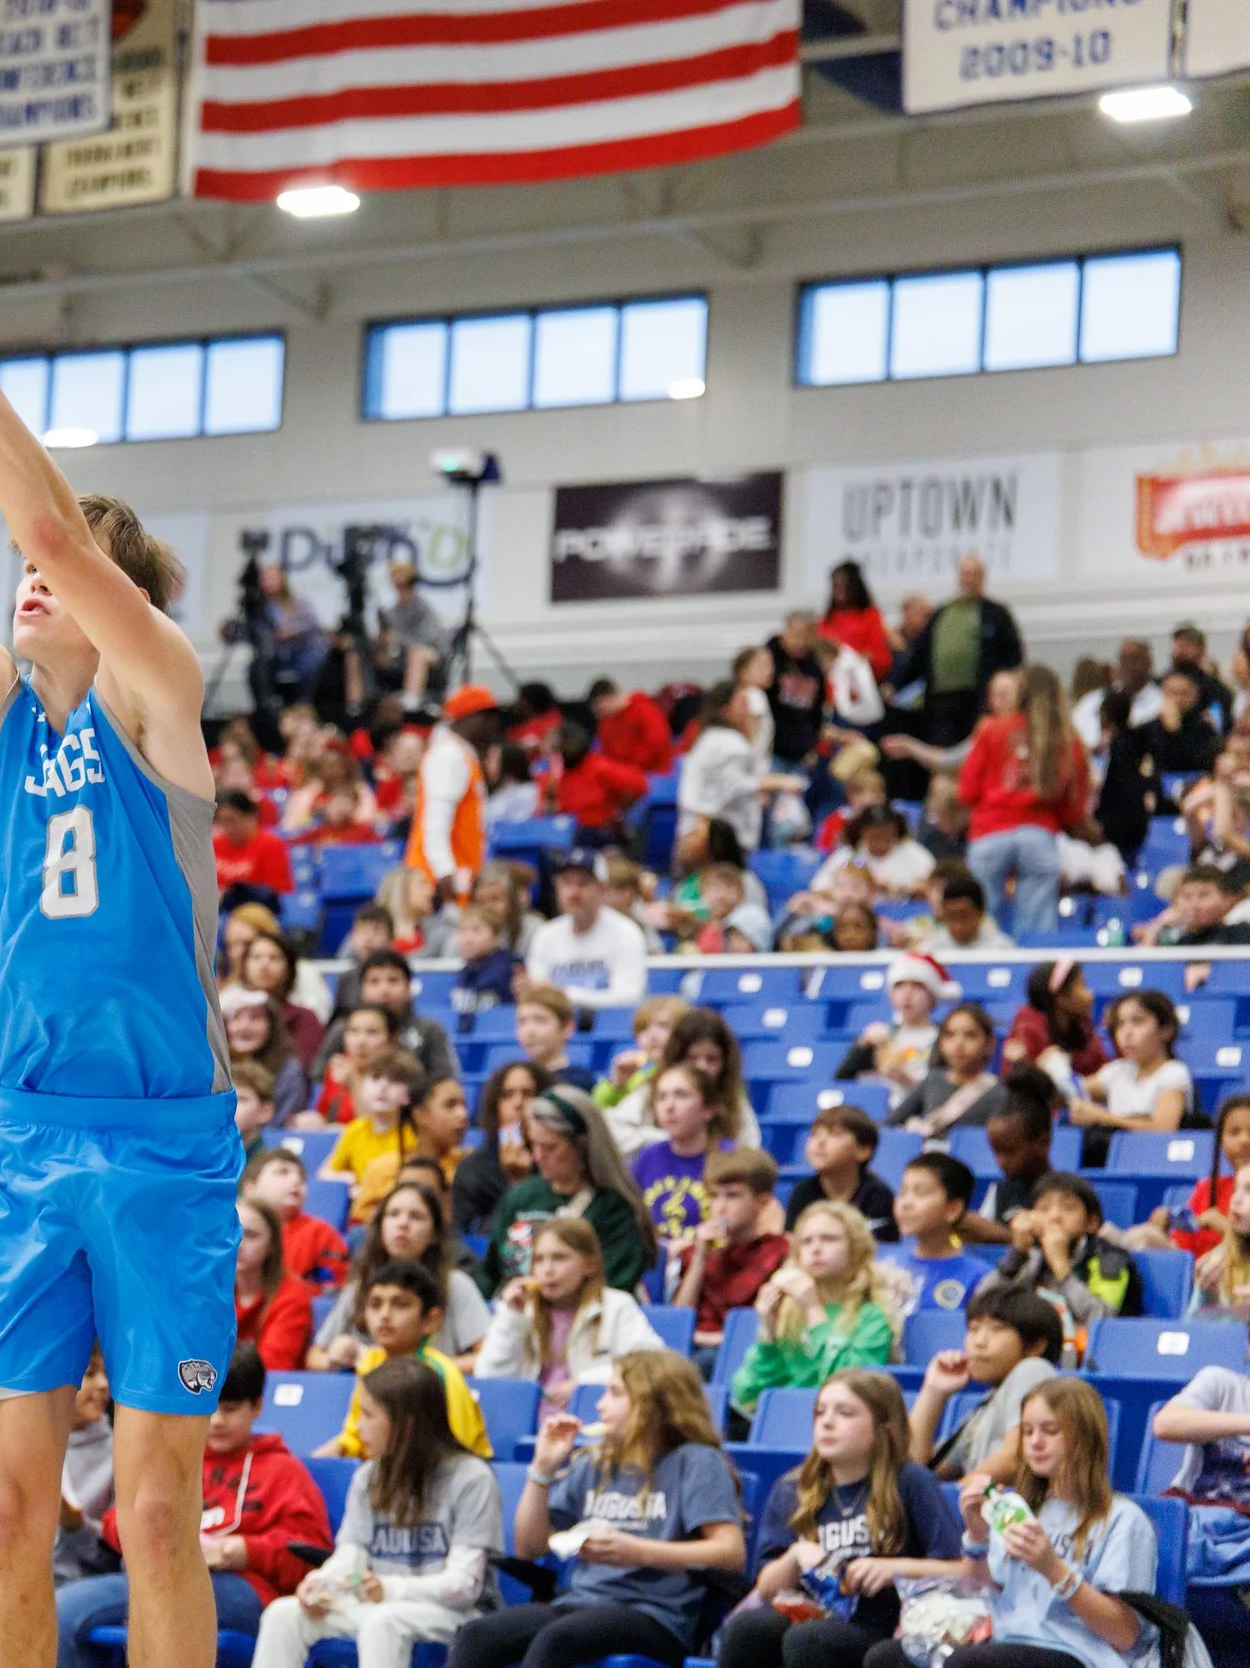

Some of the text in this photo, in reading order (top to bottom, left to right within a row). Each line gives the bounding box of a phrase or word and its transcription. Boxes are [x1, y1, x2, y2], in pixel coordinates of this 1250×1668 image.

[934, 0, 1142, 31] CHAMP
[960, 29, 1111, 81] 2009-10
[842, 470, 1018, 543] UPTOWN
[24, 728, 105, 797] JAGS
[40, 805, 99, 920] 8
